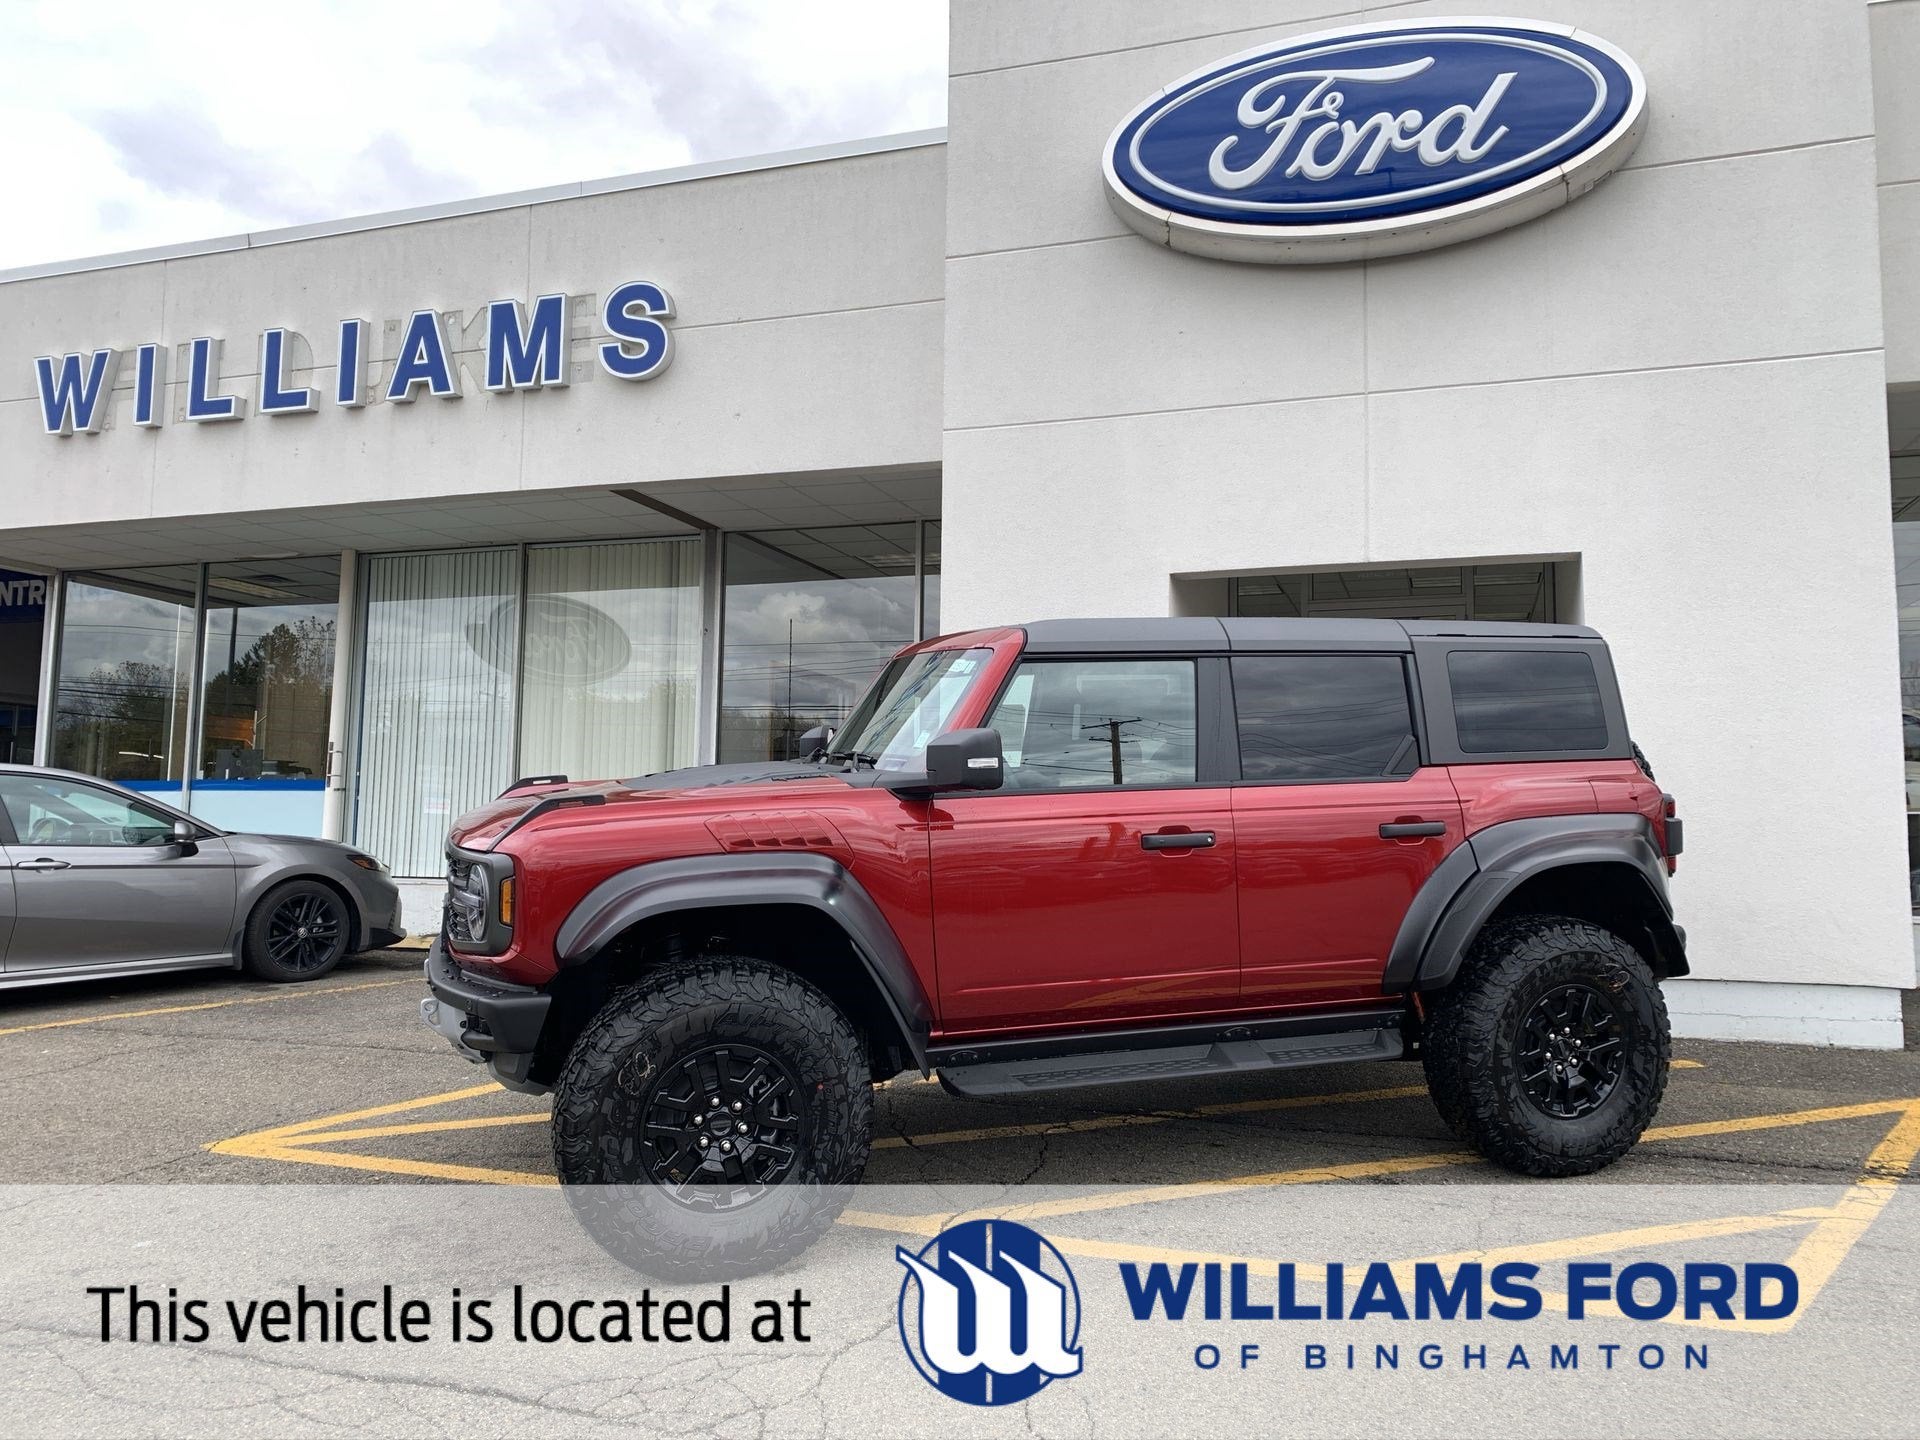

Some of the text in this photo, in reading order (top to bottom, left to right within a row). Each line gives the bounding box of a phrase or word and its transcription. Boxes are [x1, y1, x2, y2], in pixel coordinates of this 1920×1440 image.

[1208, 56, 1518, 190] Ford
[34, 281, 674, 436] WILLIAMS
[0, 579, 46, 606] NTR
